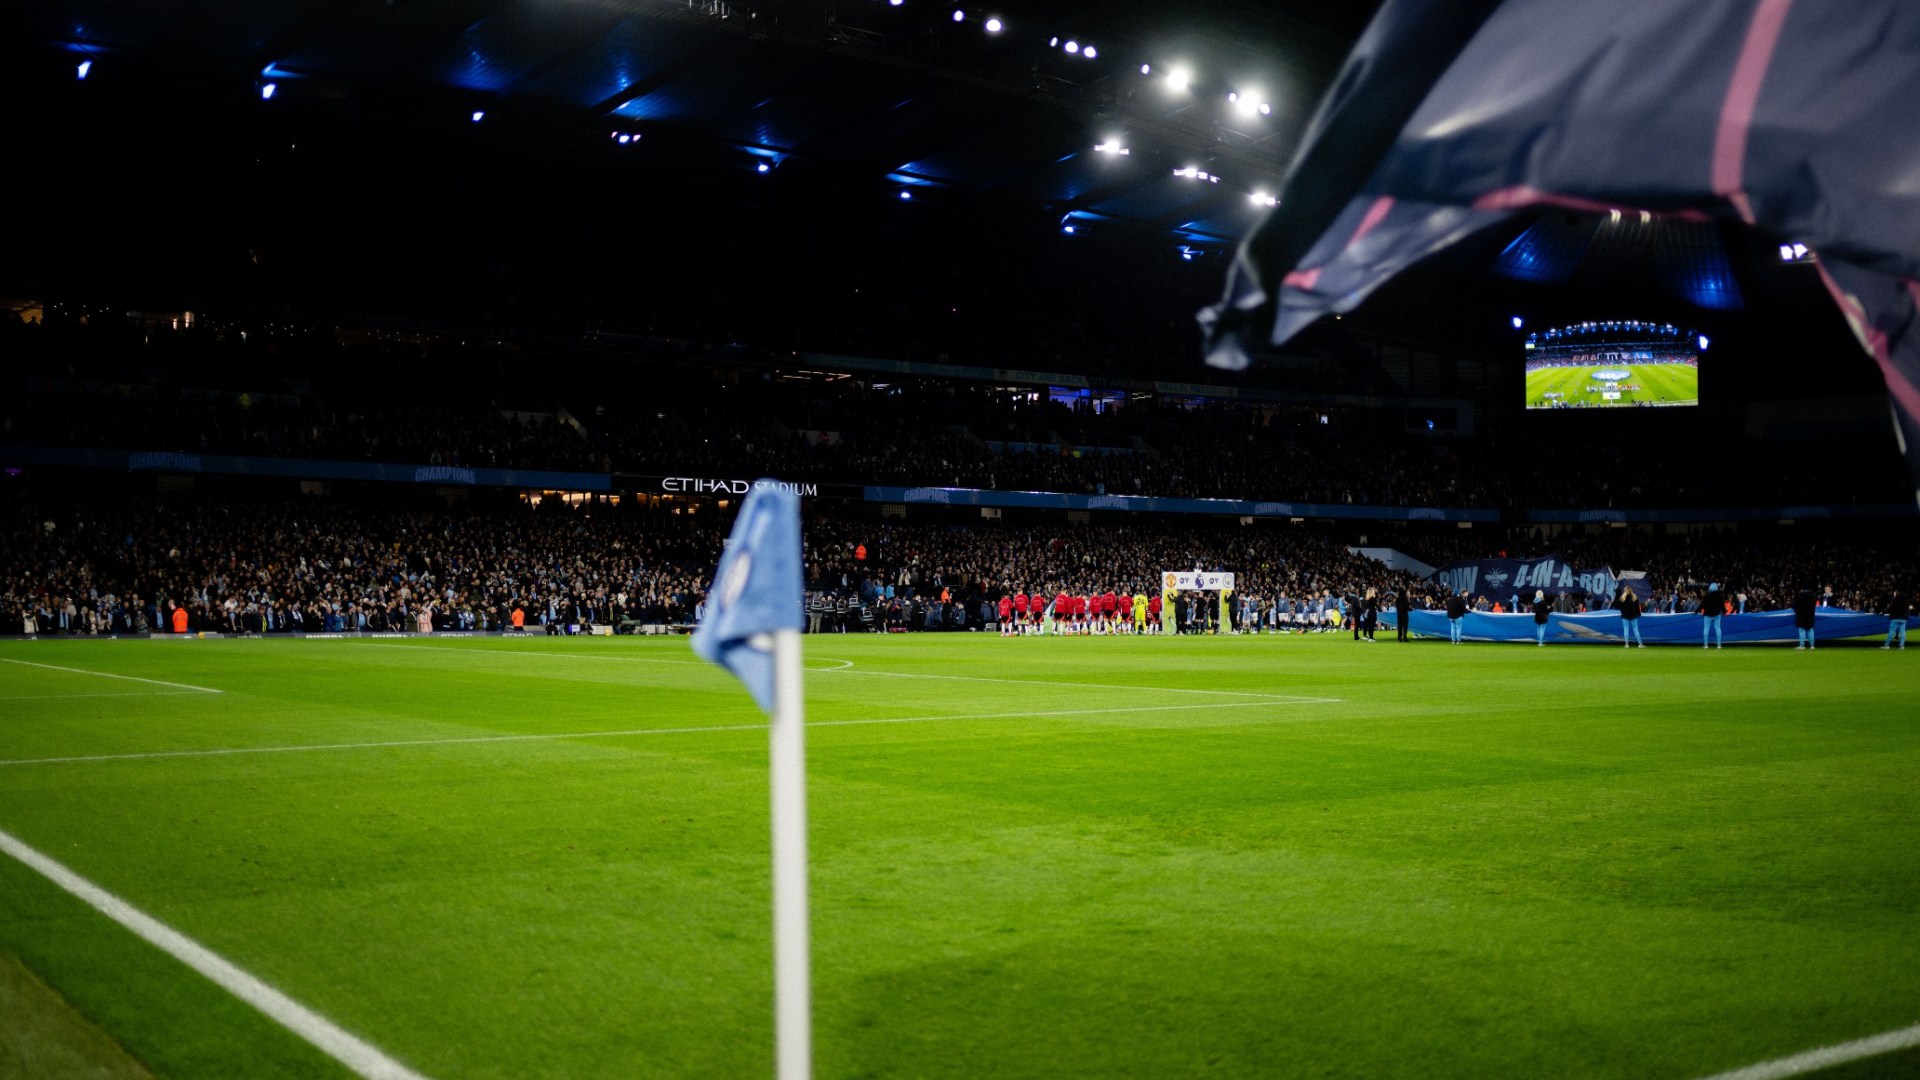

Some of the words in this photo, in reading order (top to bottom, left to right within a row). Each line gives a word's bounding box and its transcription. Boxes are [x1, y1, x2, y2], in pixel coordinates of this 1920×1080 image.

[415, 466, 476, 485] CHAMPIONS
[661, 477, 750, 494] ETIHAD
[754, 481, 817, 496] STADIUM
[904, 488, 950, 503] CHAMPIONS
[1088, 495, 1129, 510] CHAMPIONS
